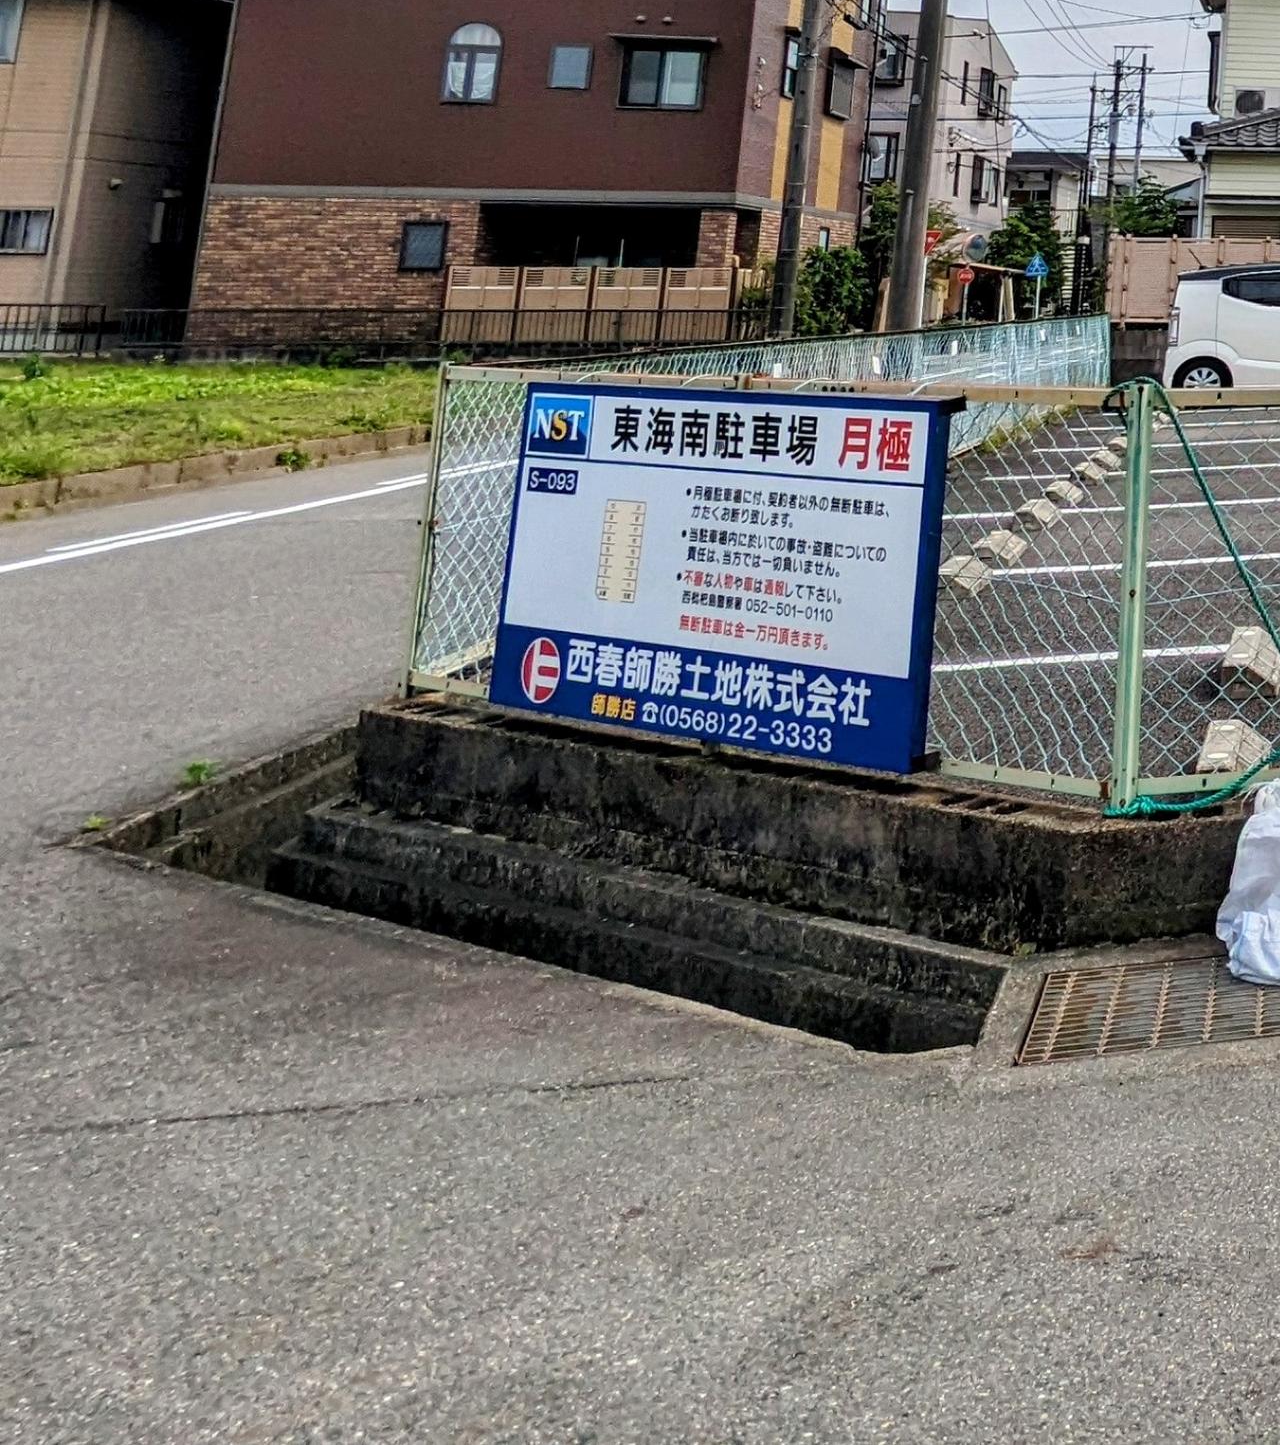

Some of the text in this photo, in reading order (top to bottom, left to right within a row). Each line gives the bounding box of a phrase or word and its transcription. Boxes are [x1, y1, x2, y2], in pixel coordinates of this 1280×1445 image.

[532, 408, 585, 442] NST
[611, 405, 913, 472] 東海南駐車場 月極
[530, 471, 577, 492] S-093
[691, 505, 795, 529] かたくお断り致します。
[686, 545, 840, 579] 責任は、当方では一切負いません。
[683, 569, 844, 605] 不審な人物や車は通報して下さい。
[745, 598, 834, 623] 052-501-0110
[679, 613, 828, 651] 無断駐車は金一万円頂きます。
[566, 637, 873, 728] 西春師勝土地株式会社
[591, 692, 833, 754] 師勝店 (0568)22-3333
